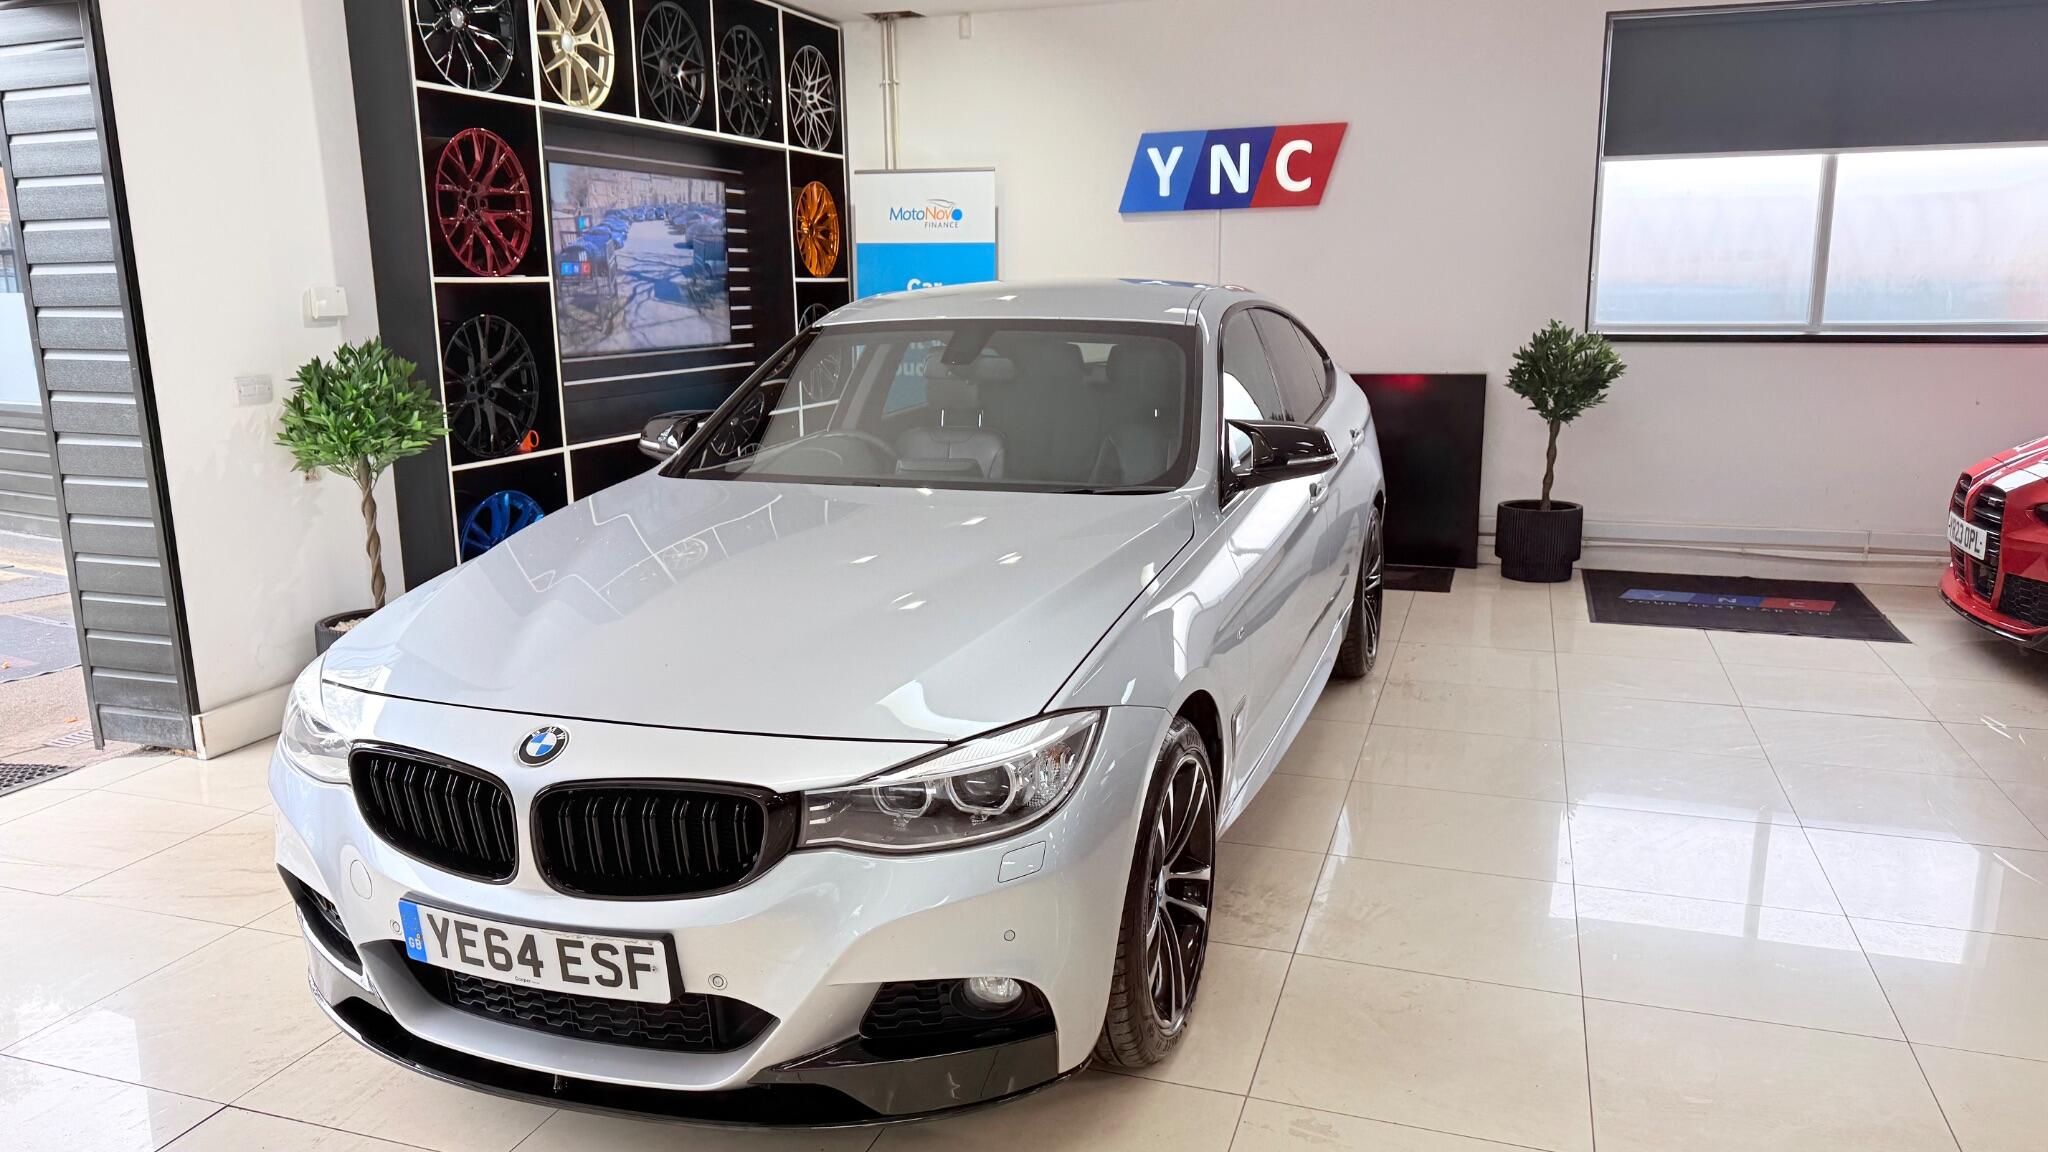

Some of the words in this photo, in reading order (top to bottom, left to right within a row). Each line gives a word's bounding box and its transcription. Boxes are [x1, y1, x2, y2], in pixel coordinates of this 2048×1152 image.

[1147, 139, 1313, 197] YNC
[889, 206, 963, 221] MotoNovo
[924, 221, 959, 229] FINANCE
[408, 936, 422, 950] GB
[427, 913, 544, 978] YE64
[556, 938, 655, 990] ESF
